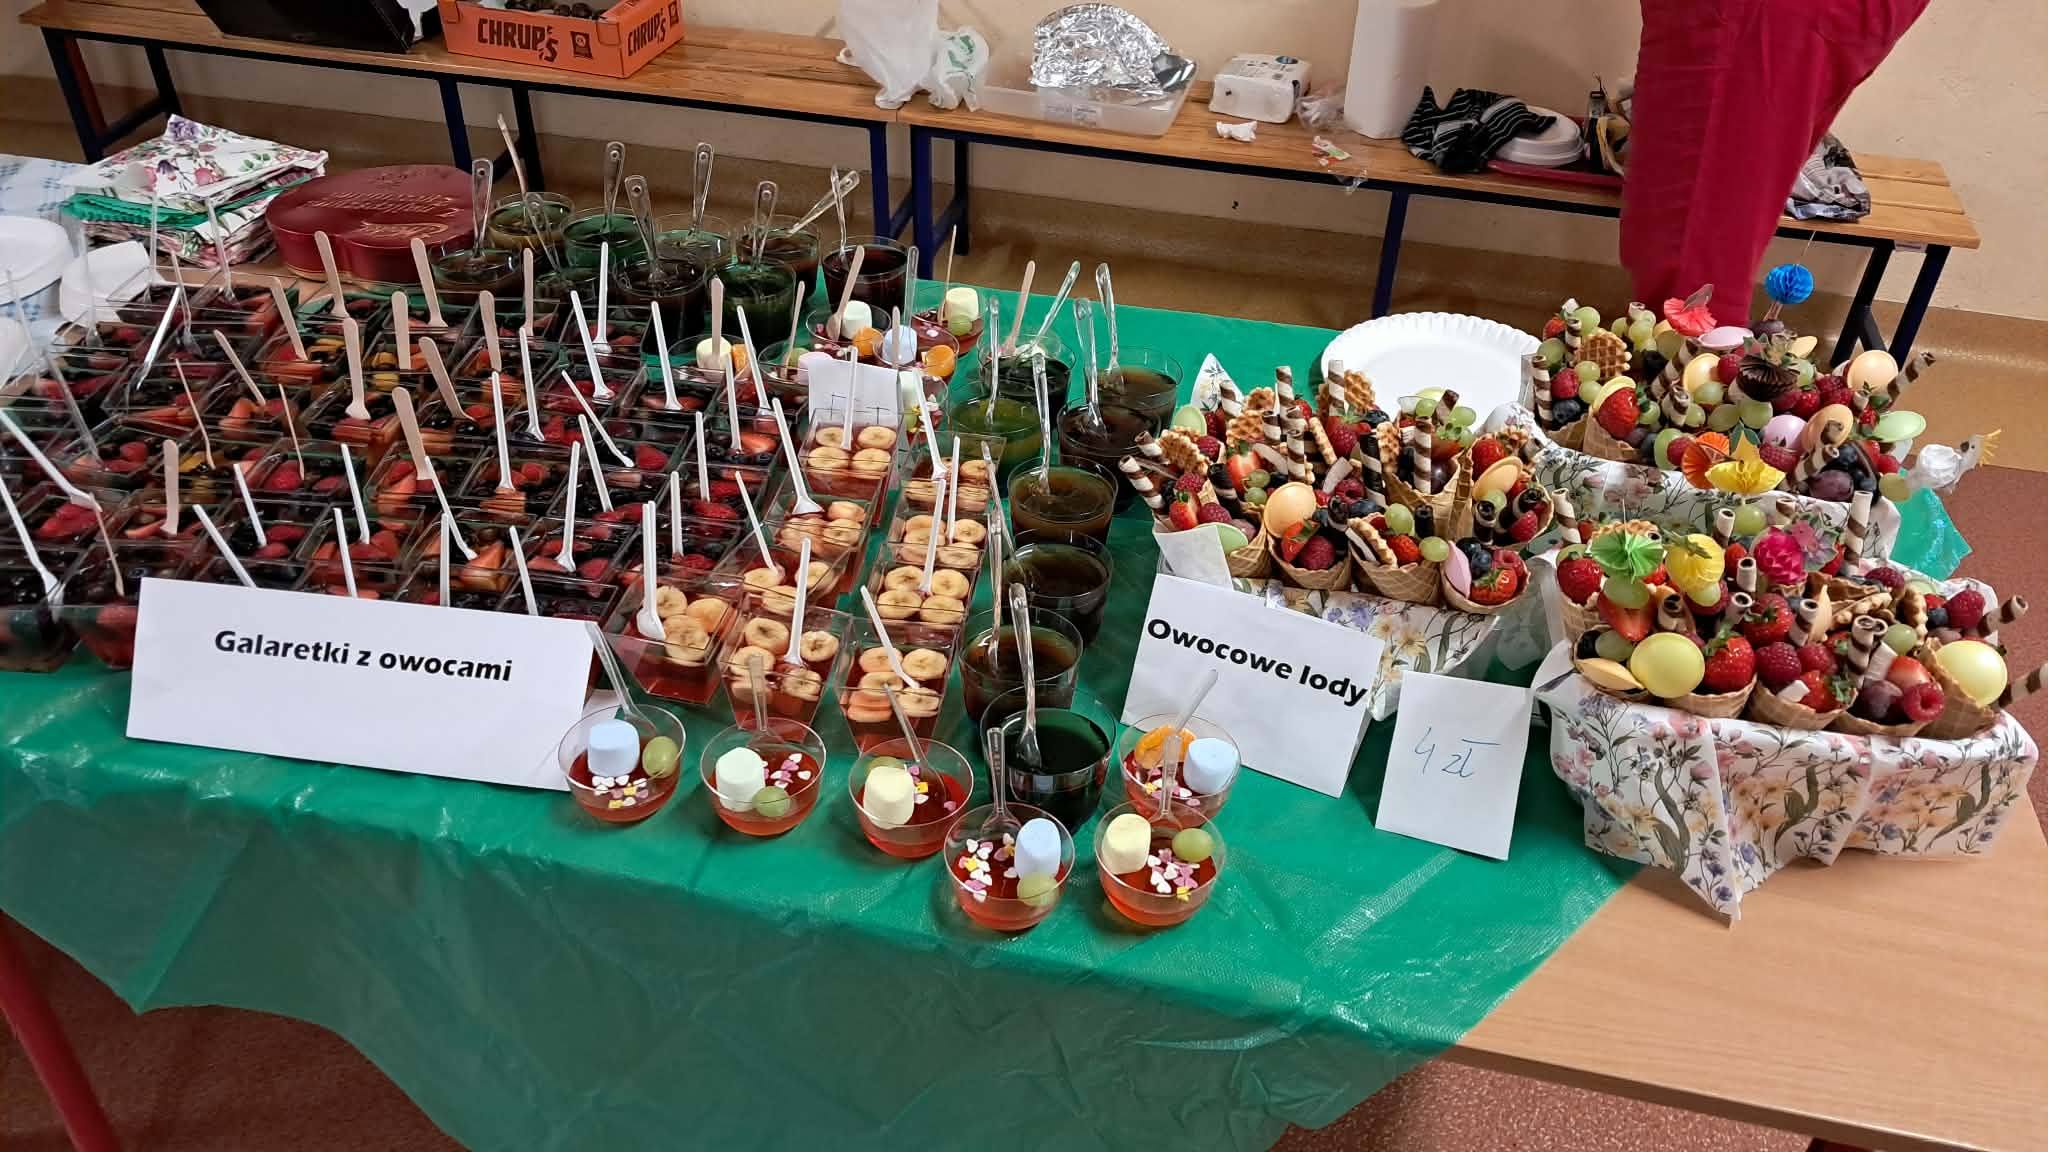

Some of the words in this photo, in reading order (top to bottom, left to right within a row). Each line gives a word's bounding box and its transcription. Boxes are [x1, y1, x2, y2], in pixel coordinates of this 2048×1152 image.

[214, 629, 350, 665] Galaretki
[356, 648, 371, 667] z
[378, 650, 513, 682] owocami
[1146, 617, 1293, 681] Owocowe
[1299, 664, 1368, 708] lody
[1414, 726, 1436, 776] 4
